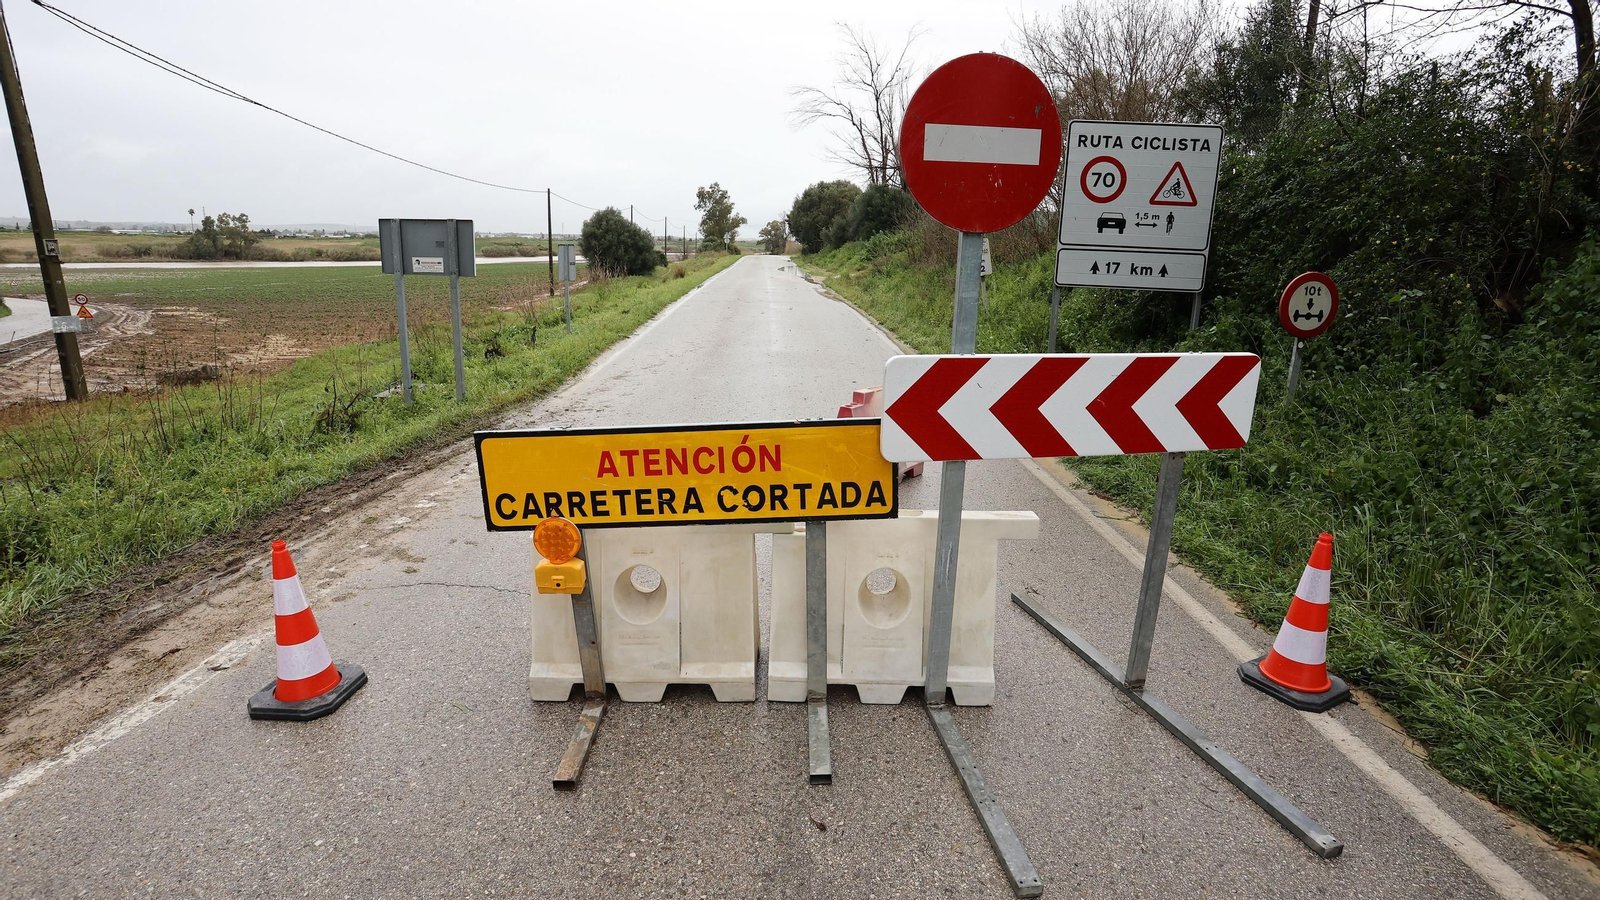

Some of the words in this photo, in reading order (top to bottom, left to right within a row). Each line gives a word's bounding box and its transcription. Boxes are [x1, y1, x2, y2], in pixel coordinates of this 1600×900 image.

[1078, 135, 1123, 149] RUTA
[1131, 136, 1211, 152] CICLISTA
[1091, 172, 1116, 188] 70
[1135, 212, 1149, 220] 1,5
[1105, 262, 1121, 275] 17
[1130, 263, 1153, 276] km
[596, 435, 782, 478] ATENCIÓN
[495, 487, 705, 520] CARRETERA
[717, 481, 887, 513] CORTADA
